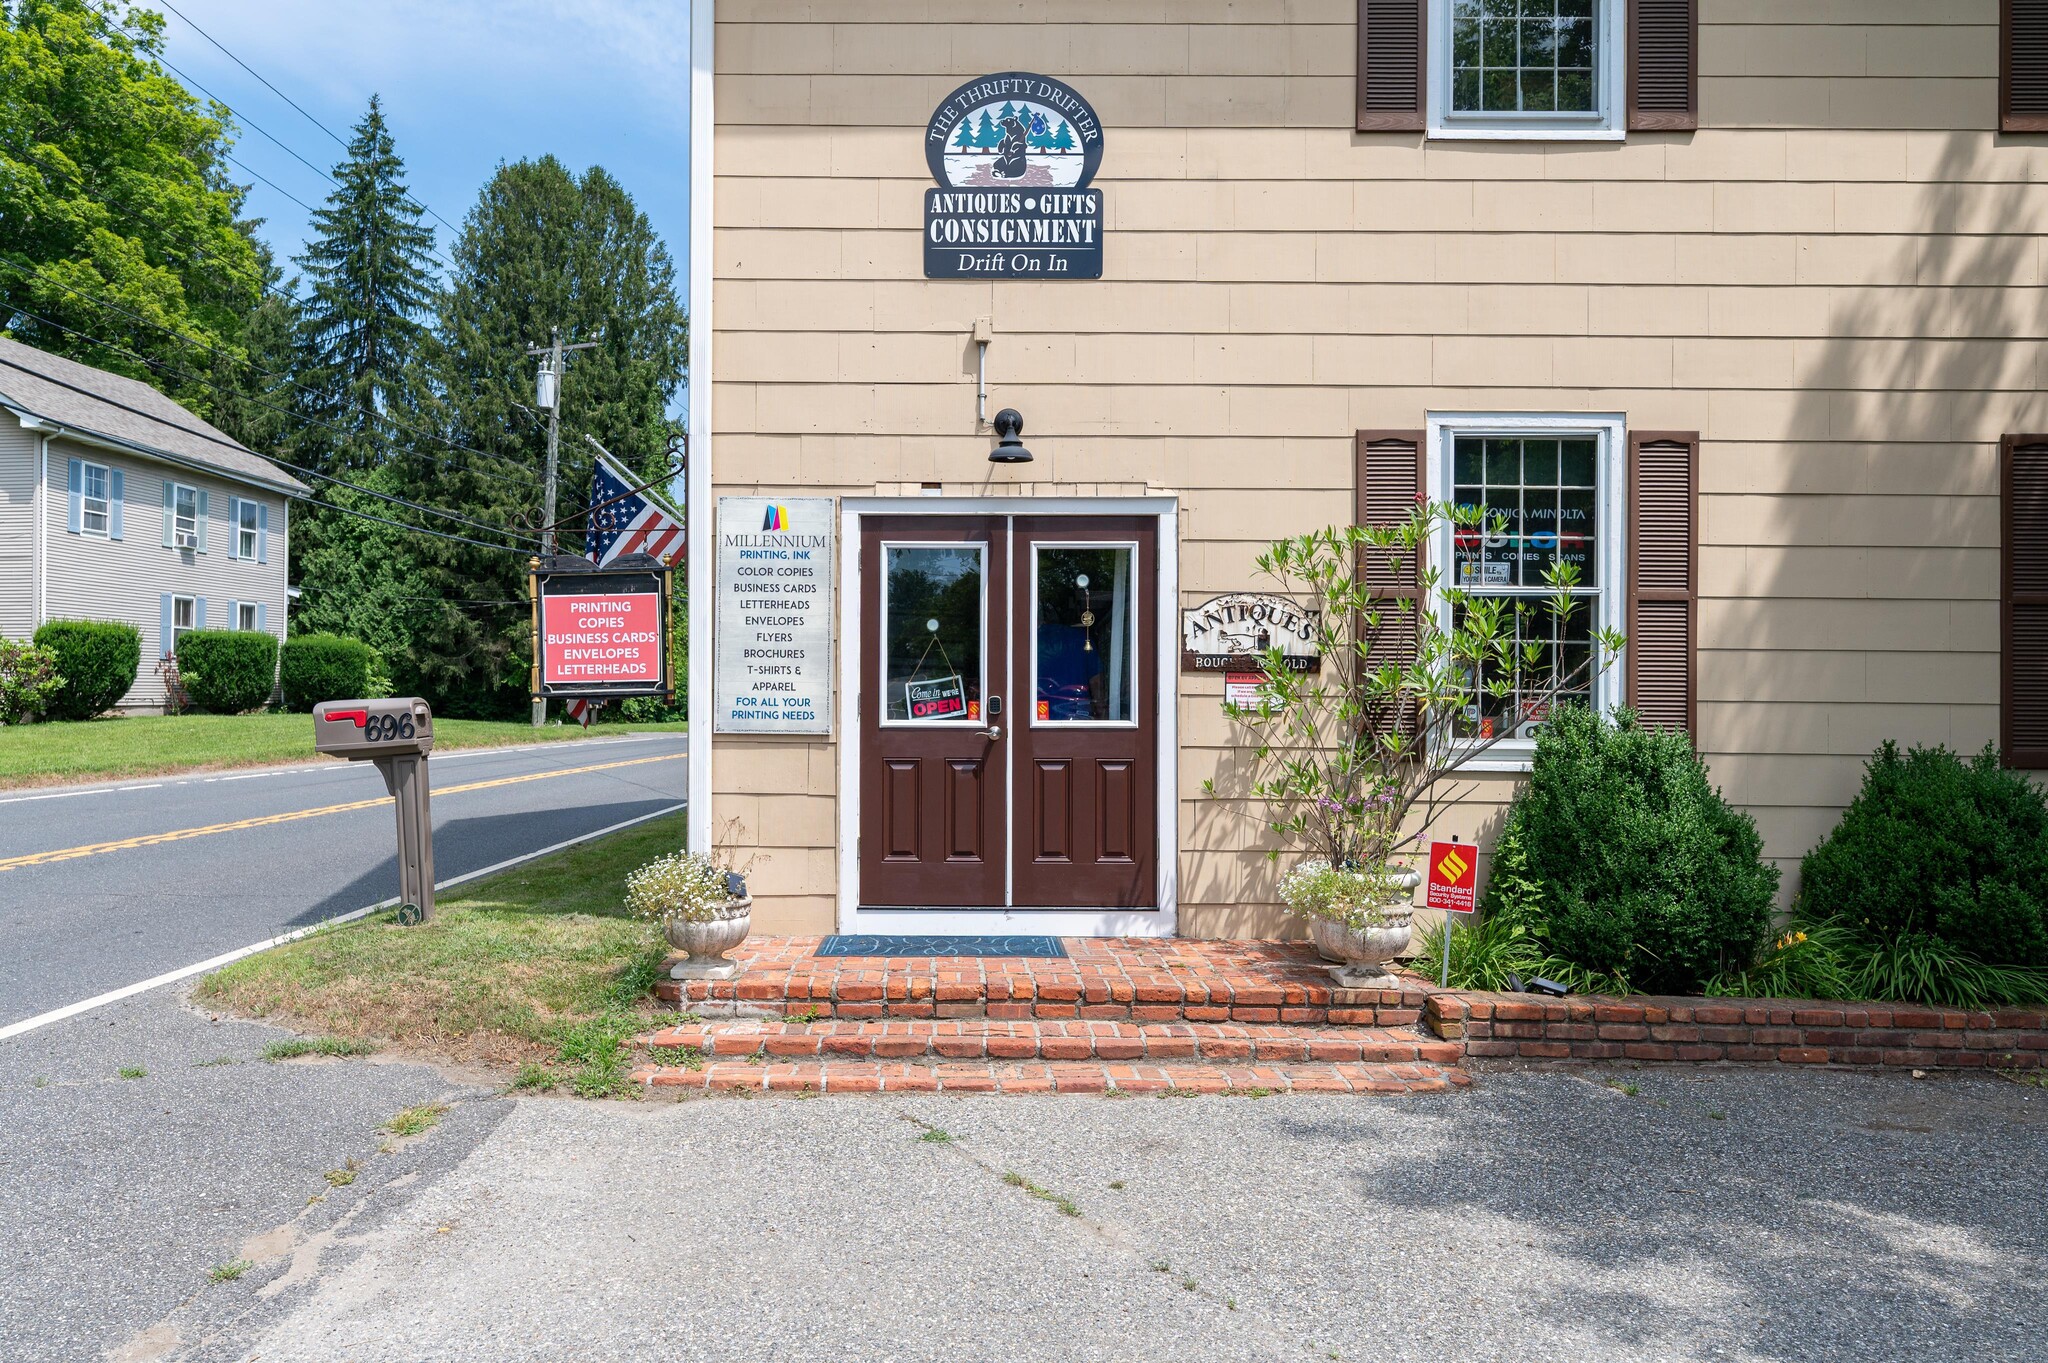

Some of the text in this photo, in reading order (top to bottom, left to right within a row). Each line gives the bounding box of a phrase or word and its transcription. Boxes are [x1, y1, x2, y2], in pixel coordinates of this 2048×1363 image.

[929, 79, 1098, 143] THE THRIFTY DRIFTER
[930, 193, 1096, 215] ANTIQUES GIFTS
[930, 219, 1096, 243] CONSIGNMENT
[957, 253, 1068, 272] Drift On In
[725, 534, 826, 548] MILLENNIUM
[1454, 529, 1584, 549] COLOR
[793, 551, 810, 560] INK
[1455, 551, 1493, 560] PRNS
[737, 566, 814, 577] COLOR COPIES
[734, 583, 817, 593] BUSINESS CARDS
[570, 601, 632, 613] PRINTING
[740, 600, 810, 610] LETTERHEADS
[578, 617, 624, 628] COPIES
[745, 616, 804, 626] ENVELOPES
[1192, 604, 1315, 640] ANTIQUES
[548, 631, 656, 645] BUSINESS CARDS
[756, 632, 793, 642] FLYERS
[564, 648, 640, 660] ENVELOPES
[743, 649, 805, 659] BROCHURES
[1195, 657, 1245, 668] BOUG
[1281, 658, 1308, 669] OLD
[557, 663, 647, 676] LETTERHEADS
[747, 665, 802, 675] T-SHIRTS &
[752, 682, 796, 692] APPAREL
[911, 687, 932, 699] Come
[942, 688, 960, 698] WE'RE
[736, 697, 811, 707] FOR ALL YOUR
[913, 698, 961, 716] OPEN
[731, 711, 815, 721] PRINTING NEEDS
[365, 712, 415, 742] 696
[1430, 882, 1472, 895] Standard
[1430, 891, 1472, 901] Security Systems
